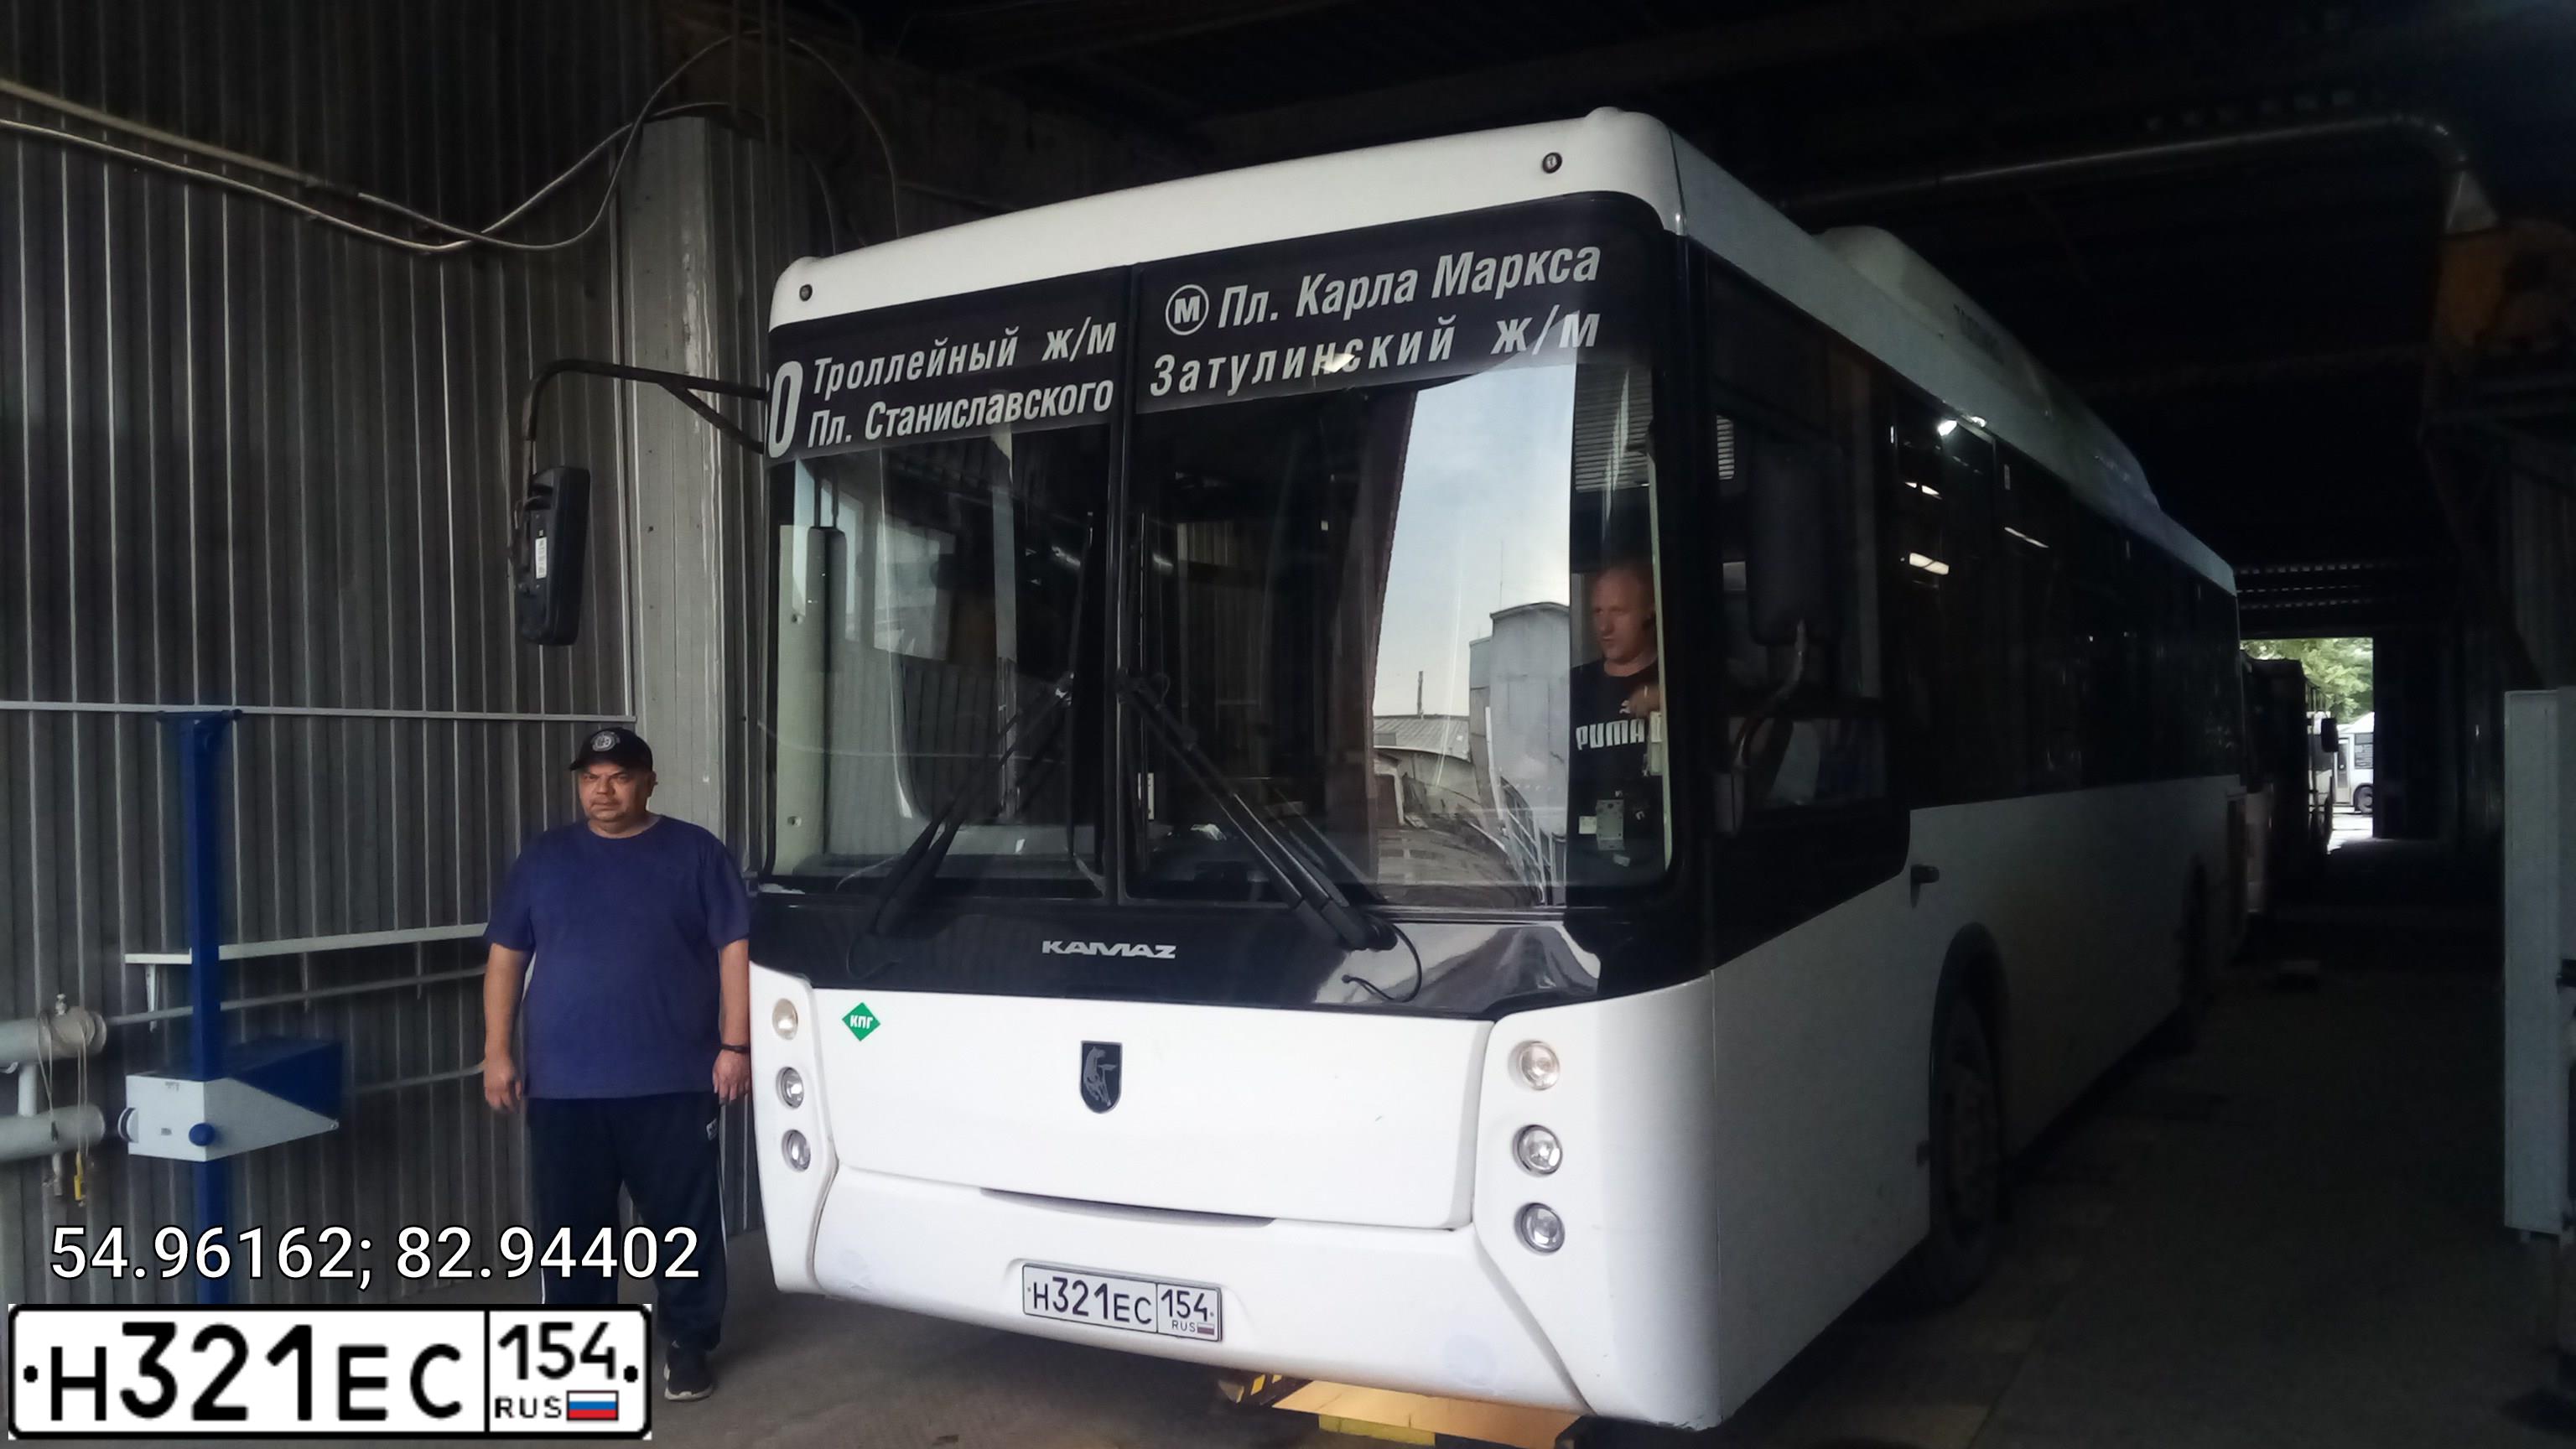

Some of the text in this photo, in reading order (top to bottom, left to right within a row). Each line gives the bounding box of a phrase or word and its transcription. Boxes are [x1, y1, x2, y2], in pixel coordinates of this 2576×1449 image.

[1218, 285, 1279, 329] Пл.
[1296, 269, 1419, 319] Карла
[1431, 247, 1601, 300] Маркса
[813, 317, 1117, 401] Троллейный ж/м
[1150, 304, 1600, 397] Затулинский ж/м
[764, 361, 803, 459] 0
[808, 379, 1114, 448] Пл. Станиславского
[1576, 718, 1645, 750] PUMA
[1041, 940, 1176, 958] KAMAZ
[849, 1014, 874, 1030] КПГ
[1033, 1276, 1208, 1325] Н321ЕС 154
[1171, 1320, 1196, 1332] RUS
